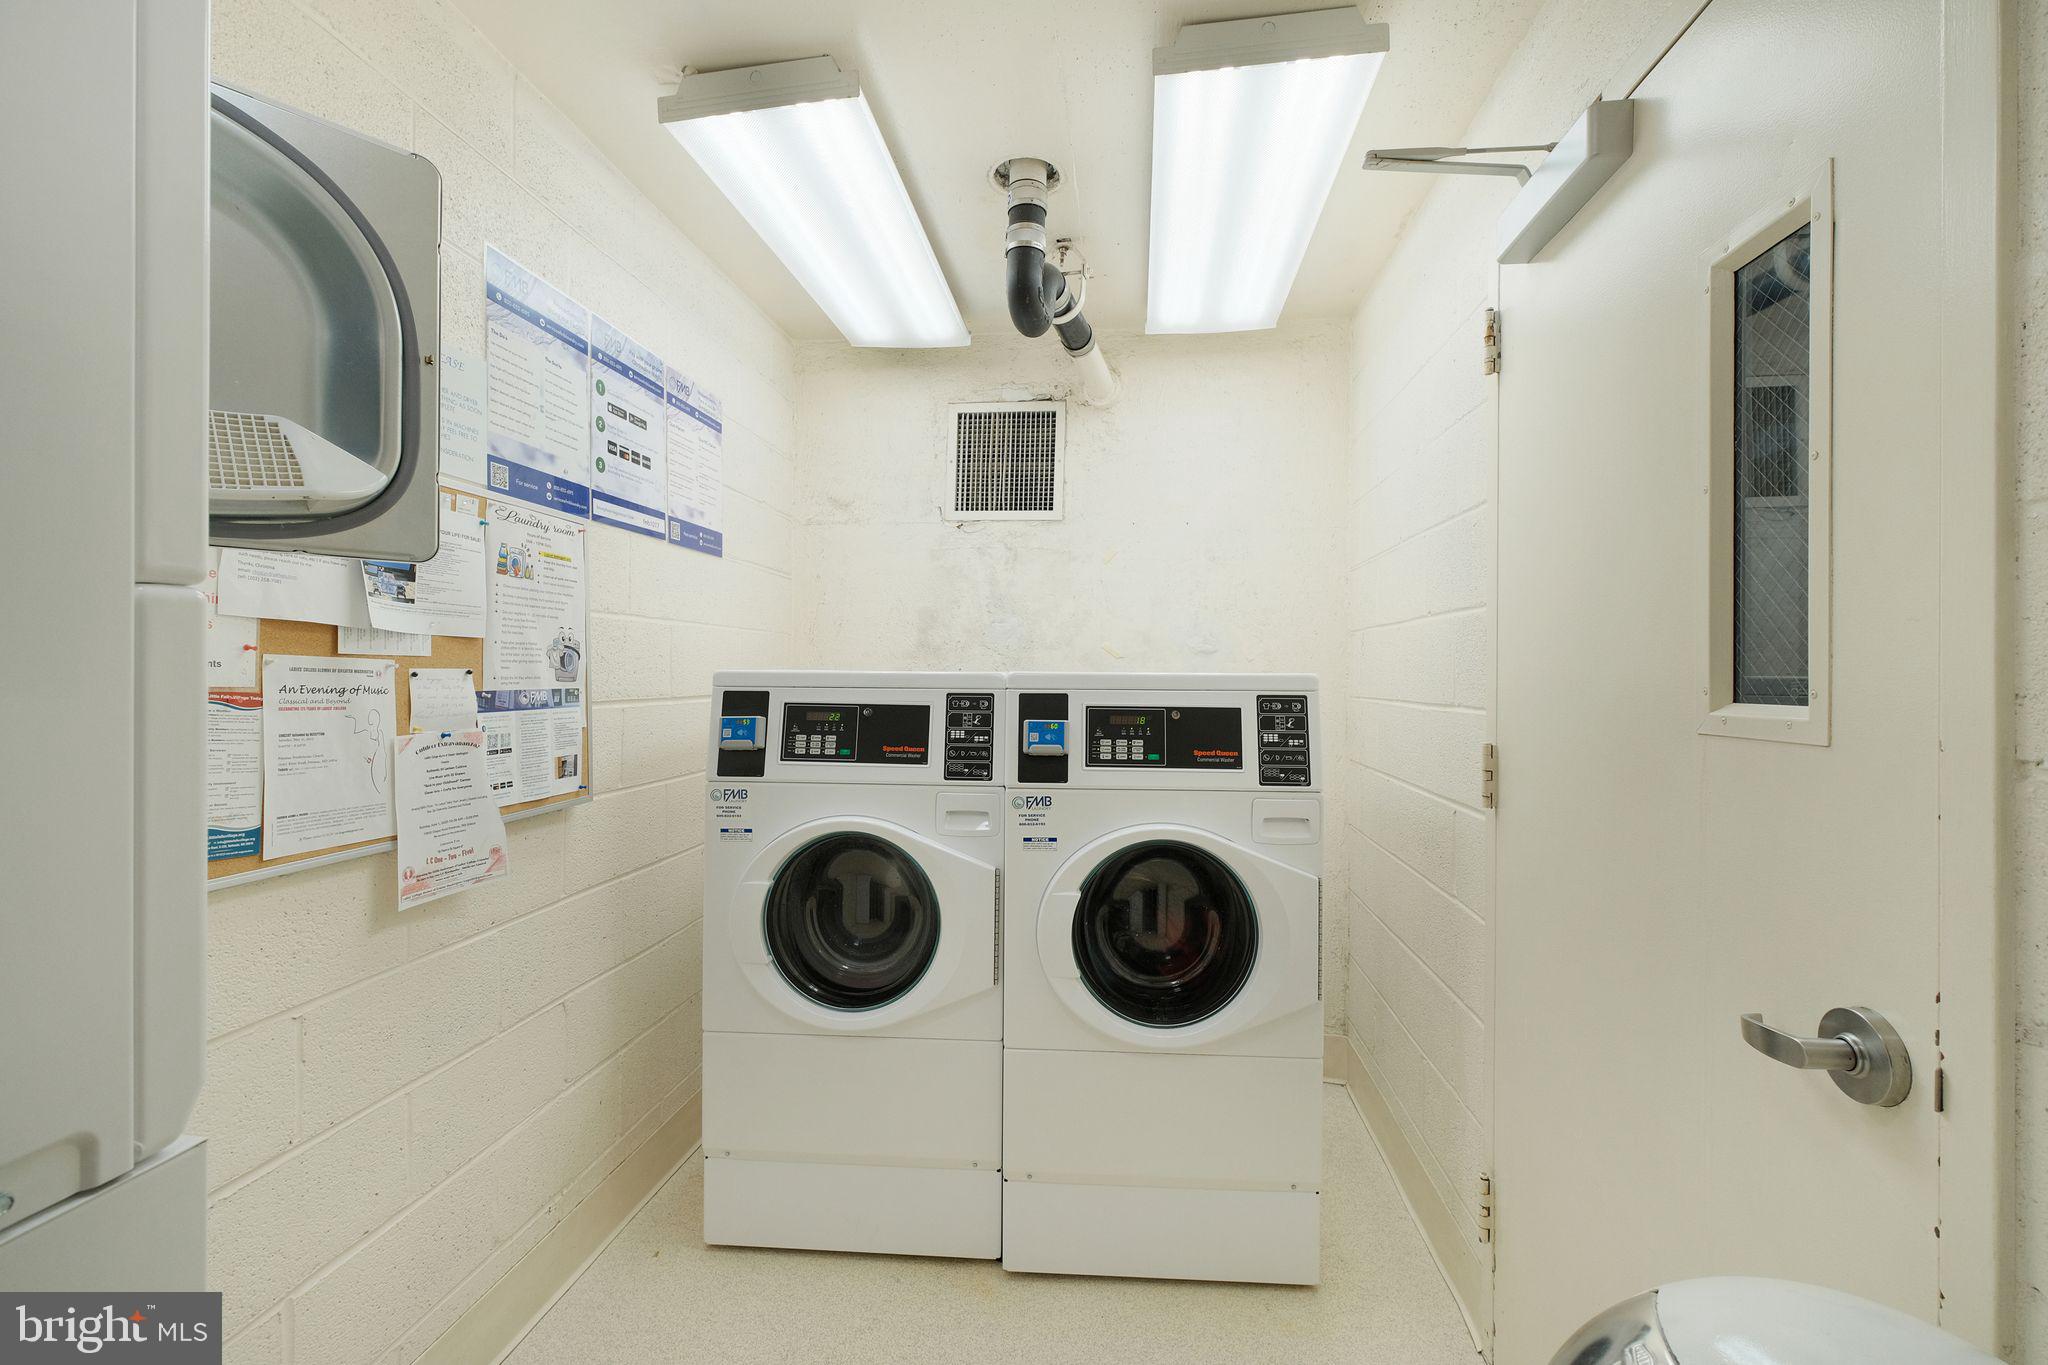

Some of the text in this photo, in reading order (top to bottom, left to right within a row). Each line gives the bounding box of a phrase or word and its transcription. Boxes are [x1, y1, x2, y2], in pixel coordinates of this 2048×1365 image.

[515, 478, 539, 491] For service
[495, 506, 576, 537] Laundry room
[279, 684, 389, 697] An Evening of Music
[529, 690, 548, 704] FMB
[828, 713, 841, 721] 22
[1136, 716, 1146, 725] 18
[723, 789, 748, 802] FMB
[1026, 796, 1052, 810] FMB
